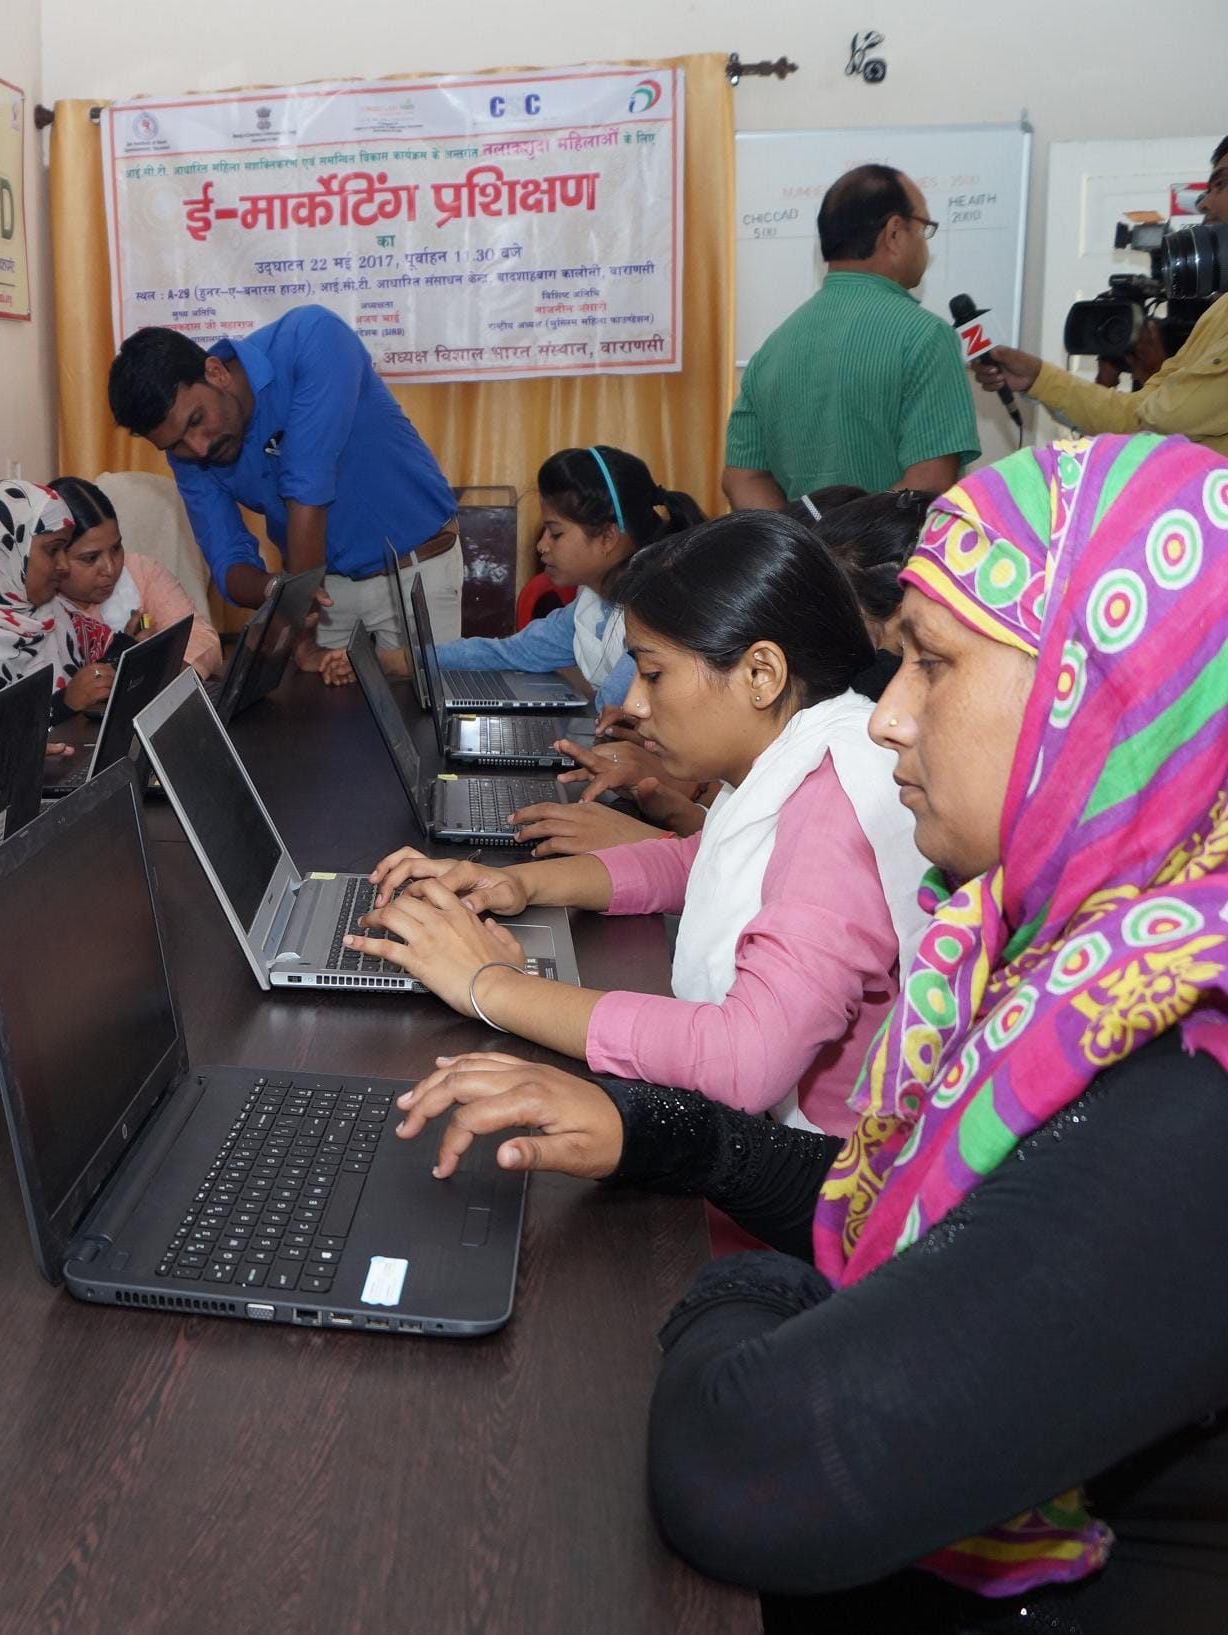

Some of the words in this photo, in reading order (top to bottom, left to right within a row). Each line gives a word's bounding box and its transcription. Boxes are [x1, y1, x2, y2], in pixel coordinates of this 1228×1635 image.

[174, 161, 208, 177] आधारित
[213, 158, 240, 174] महिला
[360, 149, 389, 166] विकास
[558, 127, 619, 152] महिलाओं
[636, 130, 656, 147] लिए
[182, 171, 420, 242] ई-मार्केटिंग
[430, 165, 600, 228] प्रशिक्षण
[310, 258, 327, 271] 22
[333, 252, 352, 270] मई
[358, 255, 400, 271] 2017,
[501, 245, 523, 261] बजे
[376, 234, 396, 248] का
[136, 289, 156, 302] स्थल
[168, 288, 190, 301] A-29
[377, 273, 421, 290] आधारित
[424, 270, 463, 287] संसाधन
[497, 266, 556, 284] बादशाहबाग
[609, 262, 654, 278] वाराणसी
[383, 349, 428, 365] अध्यक्ष
[435, 344, 484, 362] विशाल
[491, 346, 531, 361] भारत
[600, 333, 664, 354] वाराणसी
